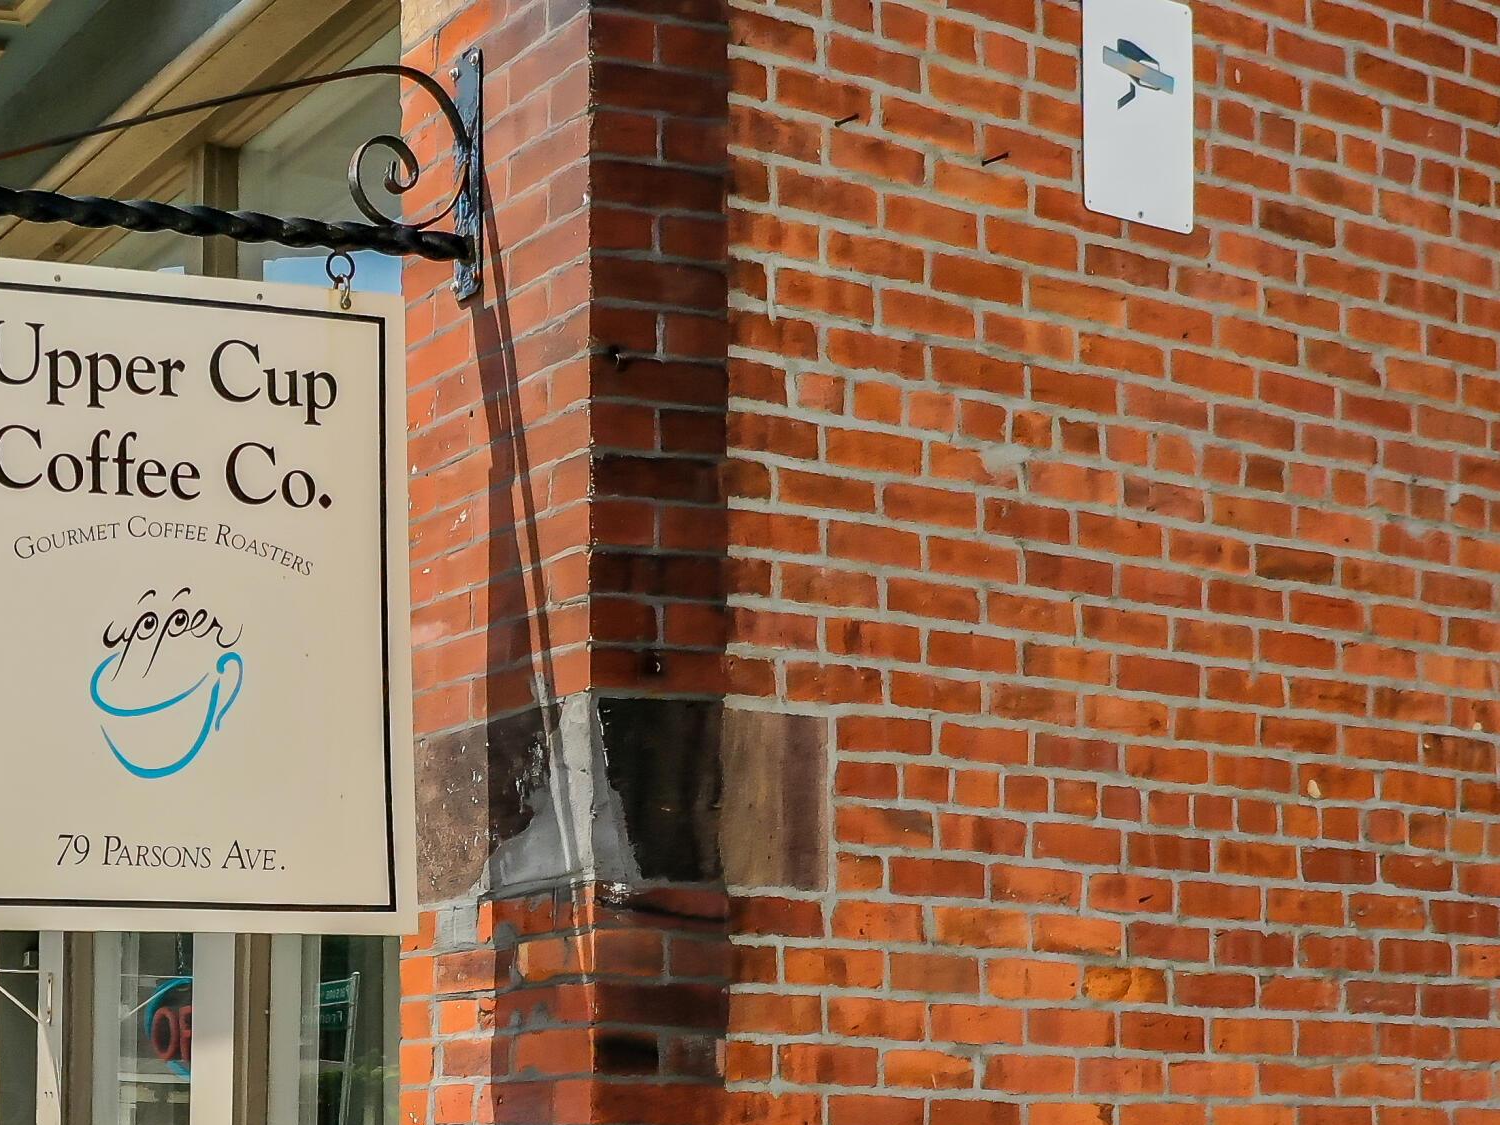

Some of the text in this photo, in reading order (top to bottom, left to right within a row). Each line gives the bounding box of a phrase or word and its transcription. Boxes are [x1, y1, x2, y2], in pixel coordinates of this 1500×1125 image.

[208, 339, 338, 426] Cup
[225, 442, 332, 510] Co.
[13, 515, 314, 576] GOURMET COFFEE ROASTERS
[102, 600, 243, 681] upper
[56, 834, 286, 871] 79 PARSONS AVE.
